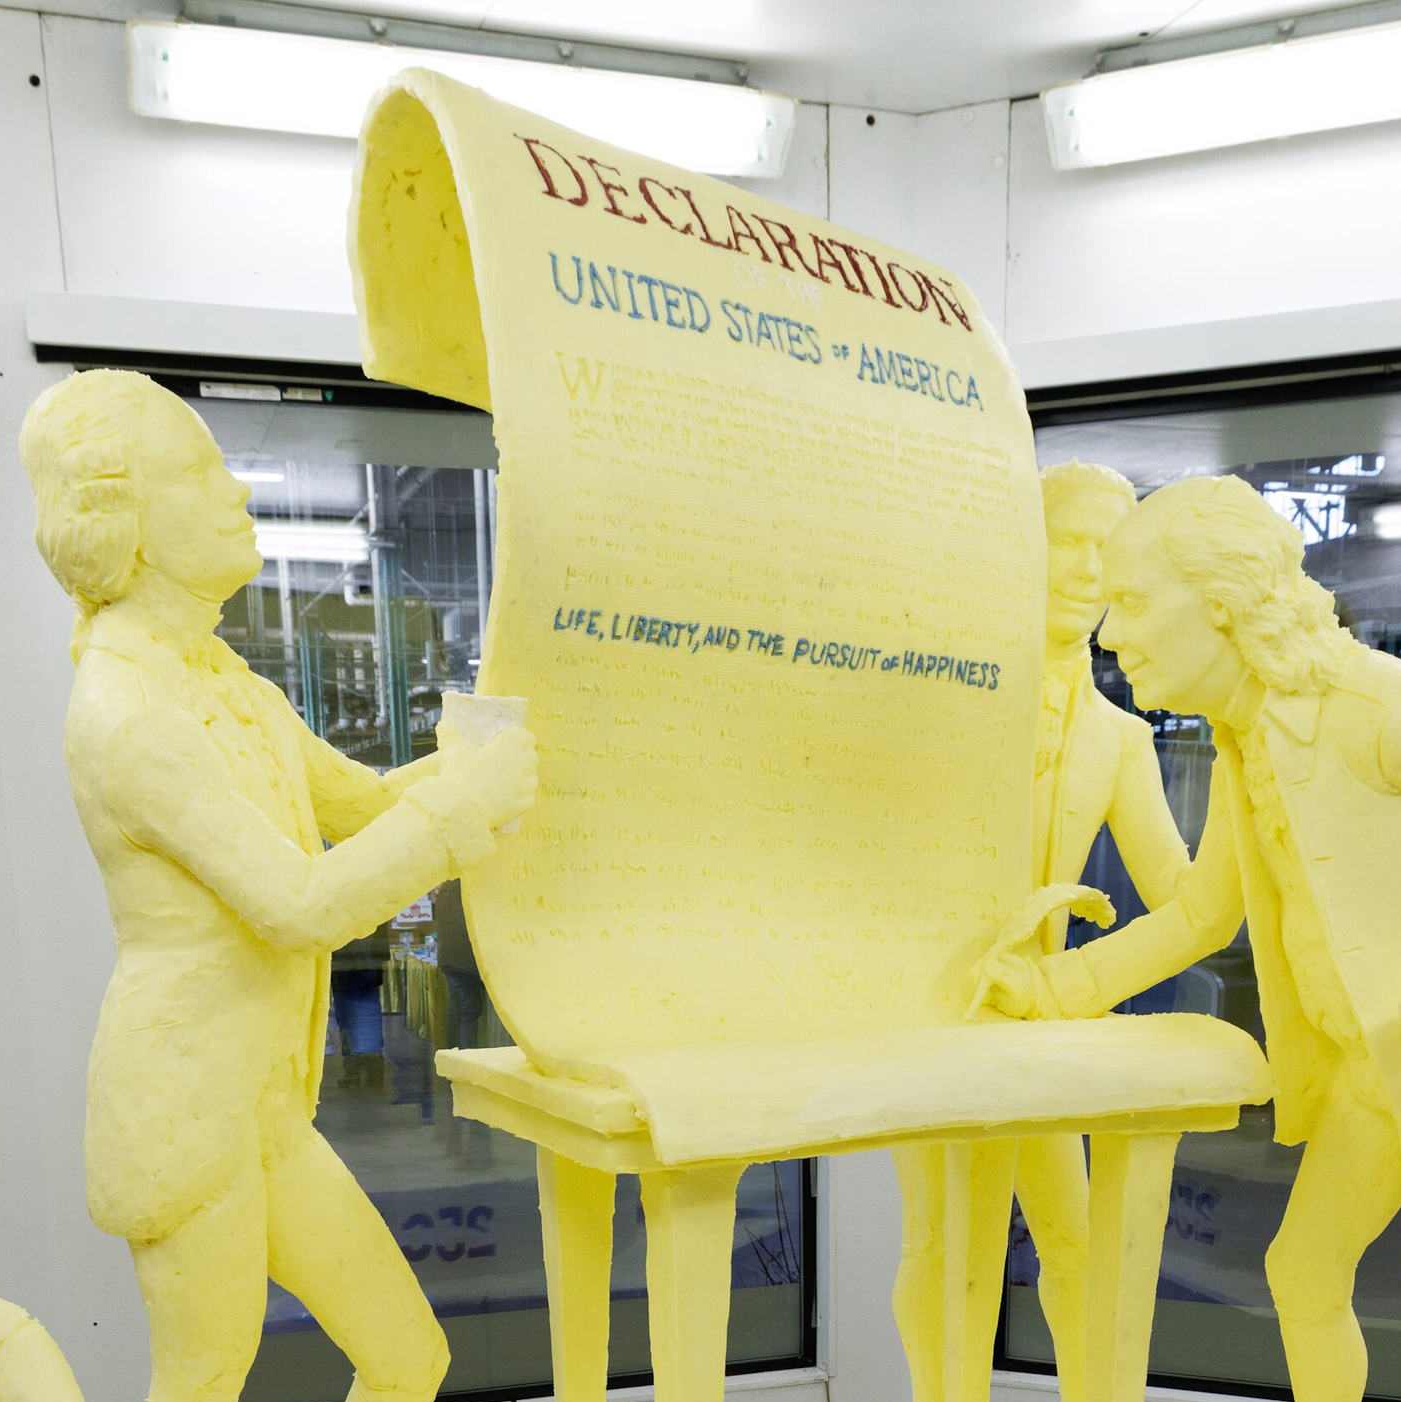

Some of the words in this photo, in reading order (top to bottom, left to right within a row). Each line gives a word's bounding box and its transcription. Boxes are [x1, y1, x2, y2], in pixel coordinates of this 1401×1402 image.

[514, 133, 973, 331] DECLARATION
[547, 251, 711, 334] UNITED
[720, 299, 824, 365] STATES
[856, 342, 984, 412] AMERICA
[553, 606, 605, 642] LIFE,
[610, 612, 701, 654] LIBERTY,
[702, 625, 741, 650] AND
[747, 628, 786, 658] THE
[791, 637, 882, 672] PURSUIT
[902, 649, 1001, 691] HAPPINESS
